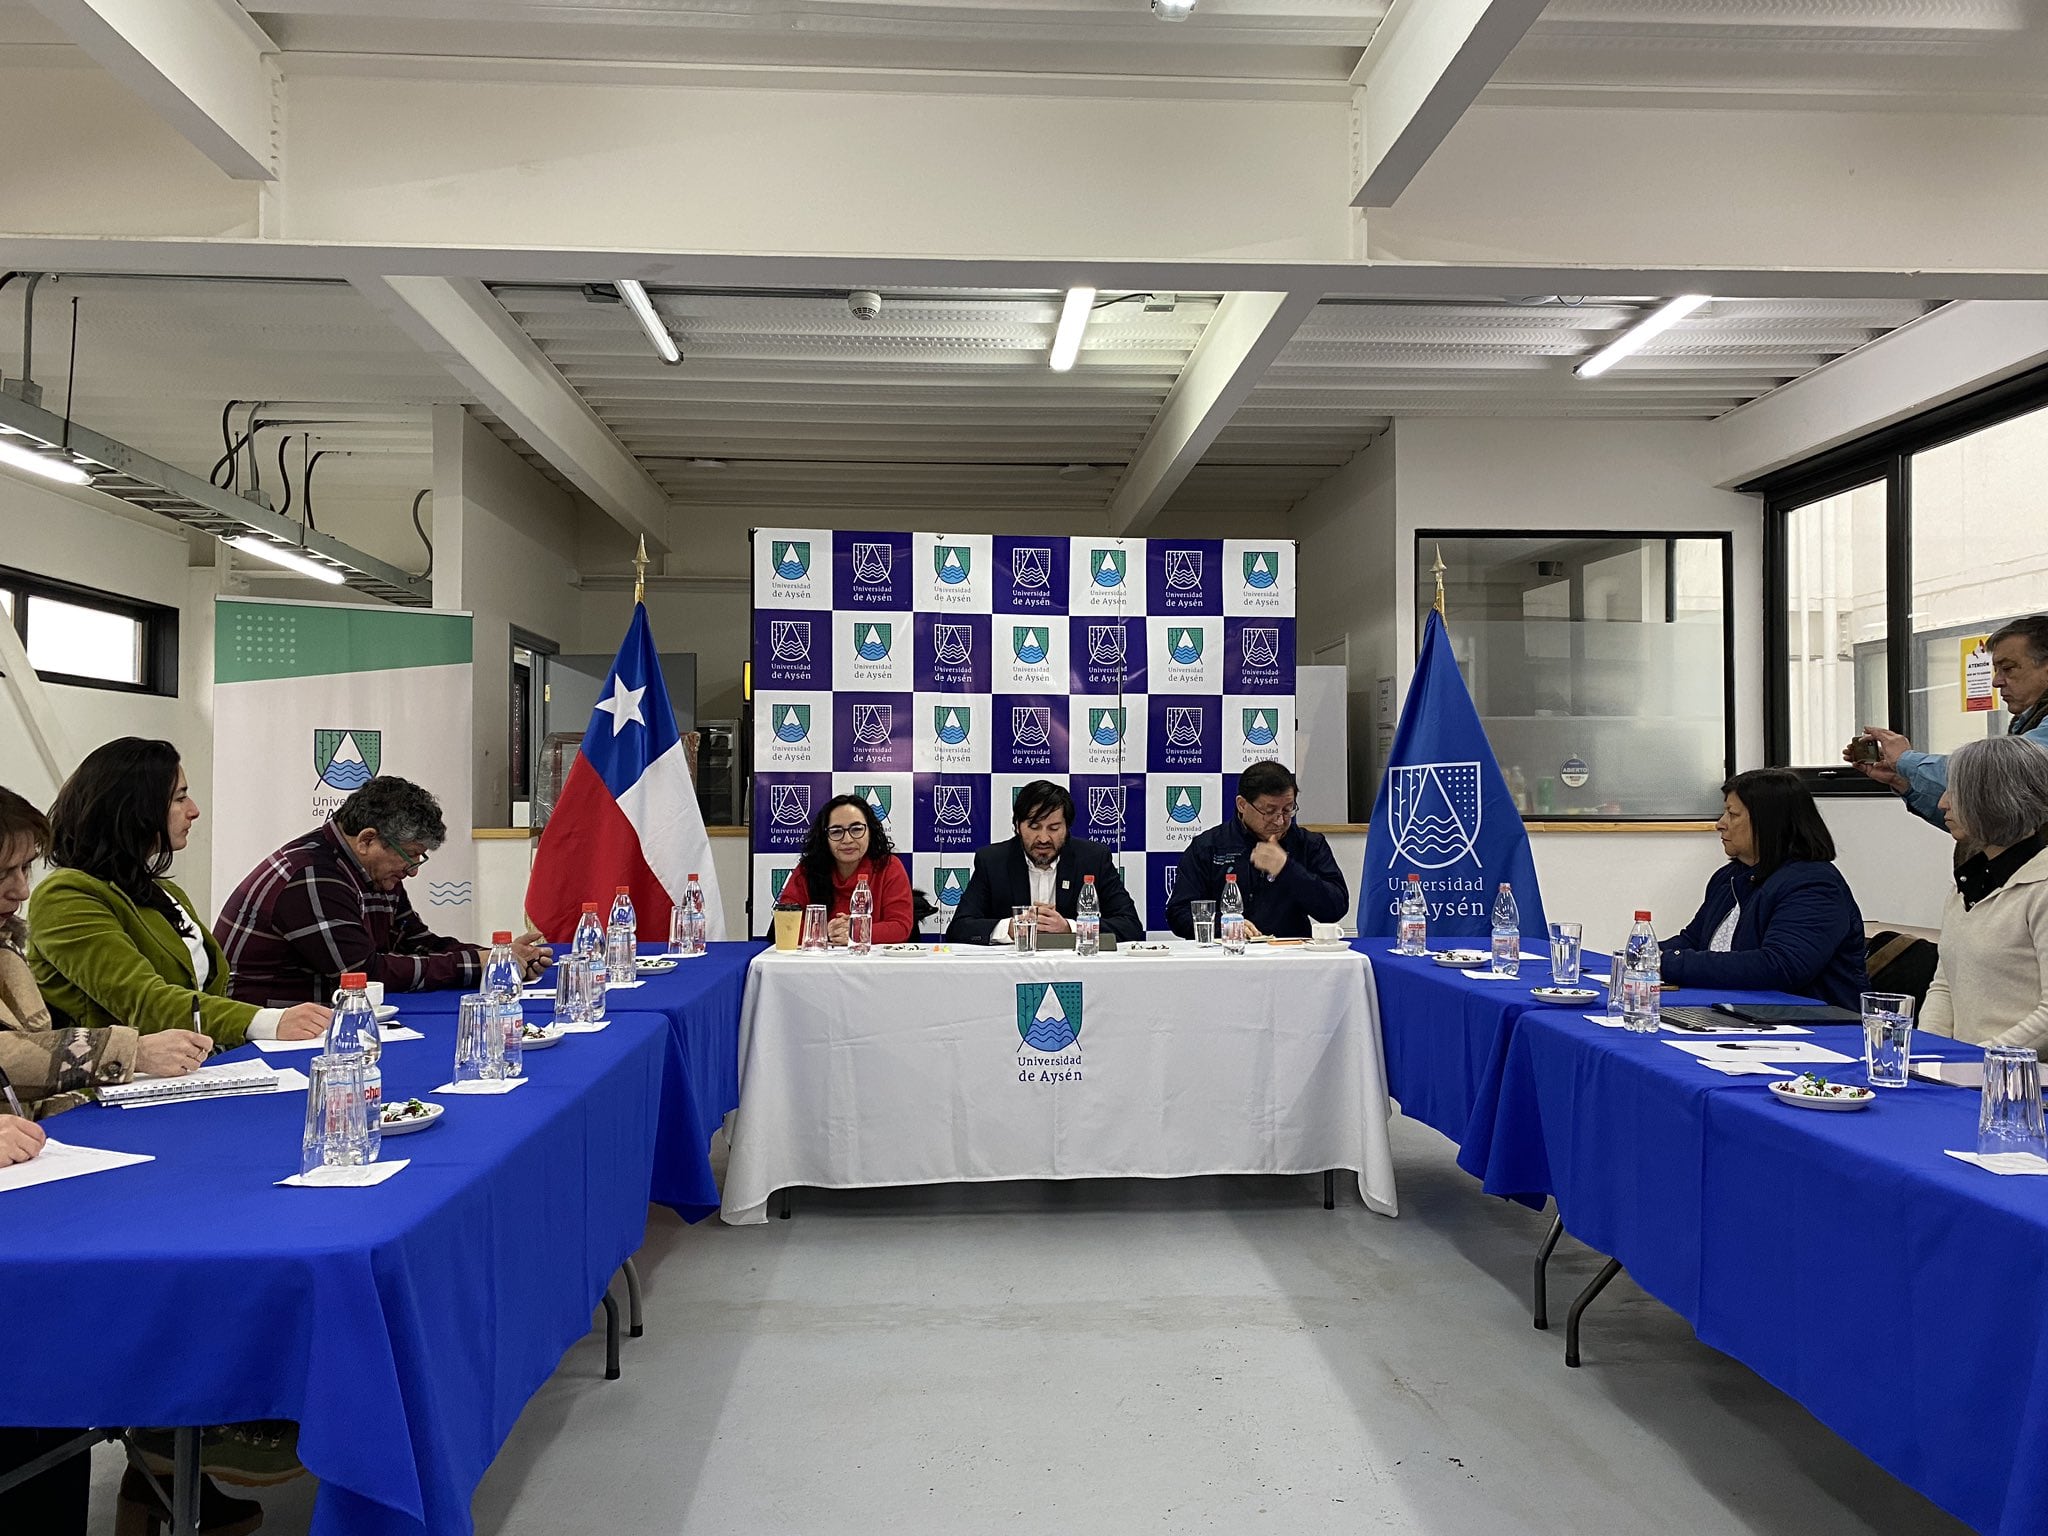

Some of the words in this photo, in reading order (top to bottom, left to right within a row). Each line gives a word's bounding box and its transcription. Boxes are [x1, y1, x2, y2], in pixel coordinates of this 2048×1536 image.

[853, 586, 892, 594] Universidad
[1013, 590, 1050, 598] Universidad
[1090, 589, 1126, 597] Universidad
[772, 590, 782, 598] de
[785, 591, 810, 600] Aysén
[853, 594, 863, 602] de
[866, 594, 892, 604] Aysén
[946, 595, 971, 603] Aysén
[1166, 592, 1202, 600] Universidad
[1243, 591, 1279, 599] Universidad
[1013, 598, 1022, 606] de
[1025, 598, 1050, 608] Aysén
[1090, 597, 1100, 605] de
[1102, 598, 1127, 606] Aysén
[1178, 599, 1203, 609] Aysén
[1256, 599, 1279, 608] Aysén
[771, 664, 810, 672] Universidad
[854, 664, 892, 672] Universidad
[1013, 667, 1049, 675] Universidad
[1168, 667, 1203, 675] Universidad
[785, 671, 810, 681] Aysén
[867, 671, 892, 681] Aysén
[1242, 669, 1279, 677] Universidad
[935, 673, 944, 681] de
[947, 674, 972, 684] Aysén
[1013, 674, 1022, 682] de
[1025, 674, 1049, 684] Aysén
[1089, 674, 1099, 682] de
[1180, 675, 1203, 684] Aysén
[1242, 677, 1251, 685] de
[1254, 676, 1279, 686] Aysén
[772, 746, 810, 754] Universidad
[1013, 749, 1050, 757] Universidad
[1166, 748, 1201, 756] Universidad
[785, 753, 810, 763] Aysén
[853, 754, 864, 762] de
[866, 754, 892, 764] Aysén
[935, 754, 944, 762] de
[946, 755, 971, 763] Aysén
[1025, 756, 1050, 766] Aysén
[1166, 756, 1175, 764] de
[1178, 756, 1201, 766] Aysén
[312, 808, 324, 817] de
[770, 835, 781, 843] de
[784, 835, 808, 845] Aysé
[935, 835, 944, 843] de
[946, 835, 972, 845] Aysén
[1089, 835, 1099, 843] de
[1166, 832, 1176, 841] de
[1388, 877, 1483, 891] Unersidad
[1426, 896, 1485, 921] ysén
[1018, 1055, 1081, 1067] Universidad
[1018, 1070, 1035, 1082] de
[1040, 1068, 1082, 1085] Aysén
